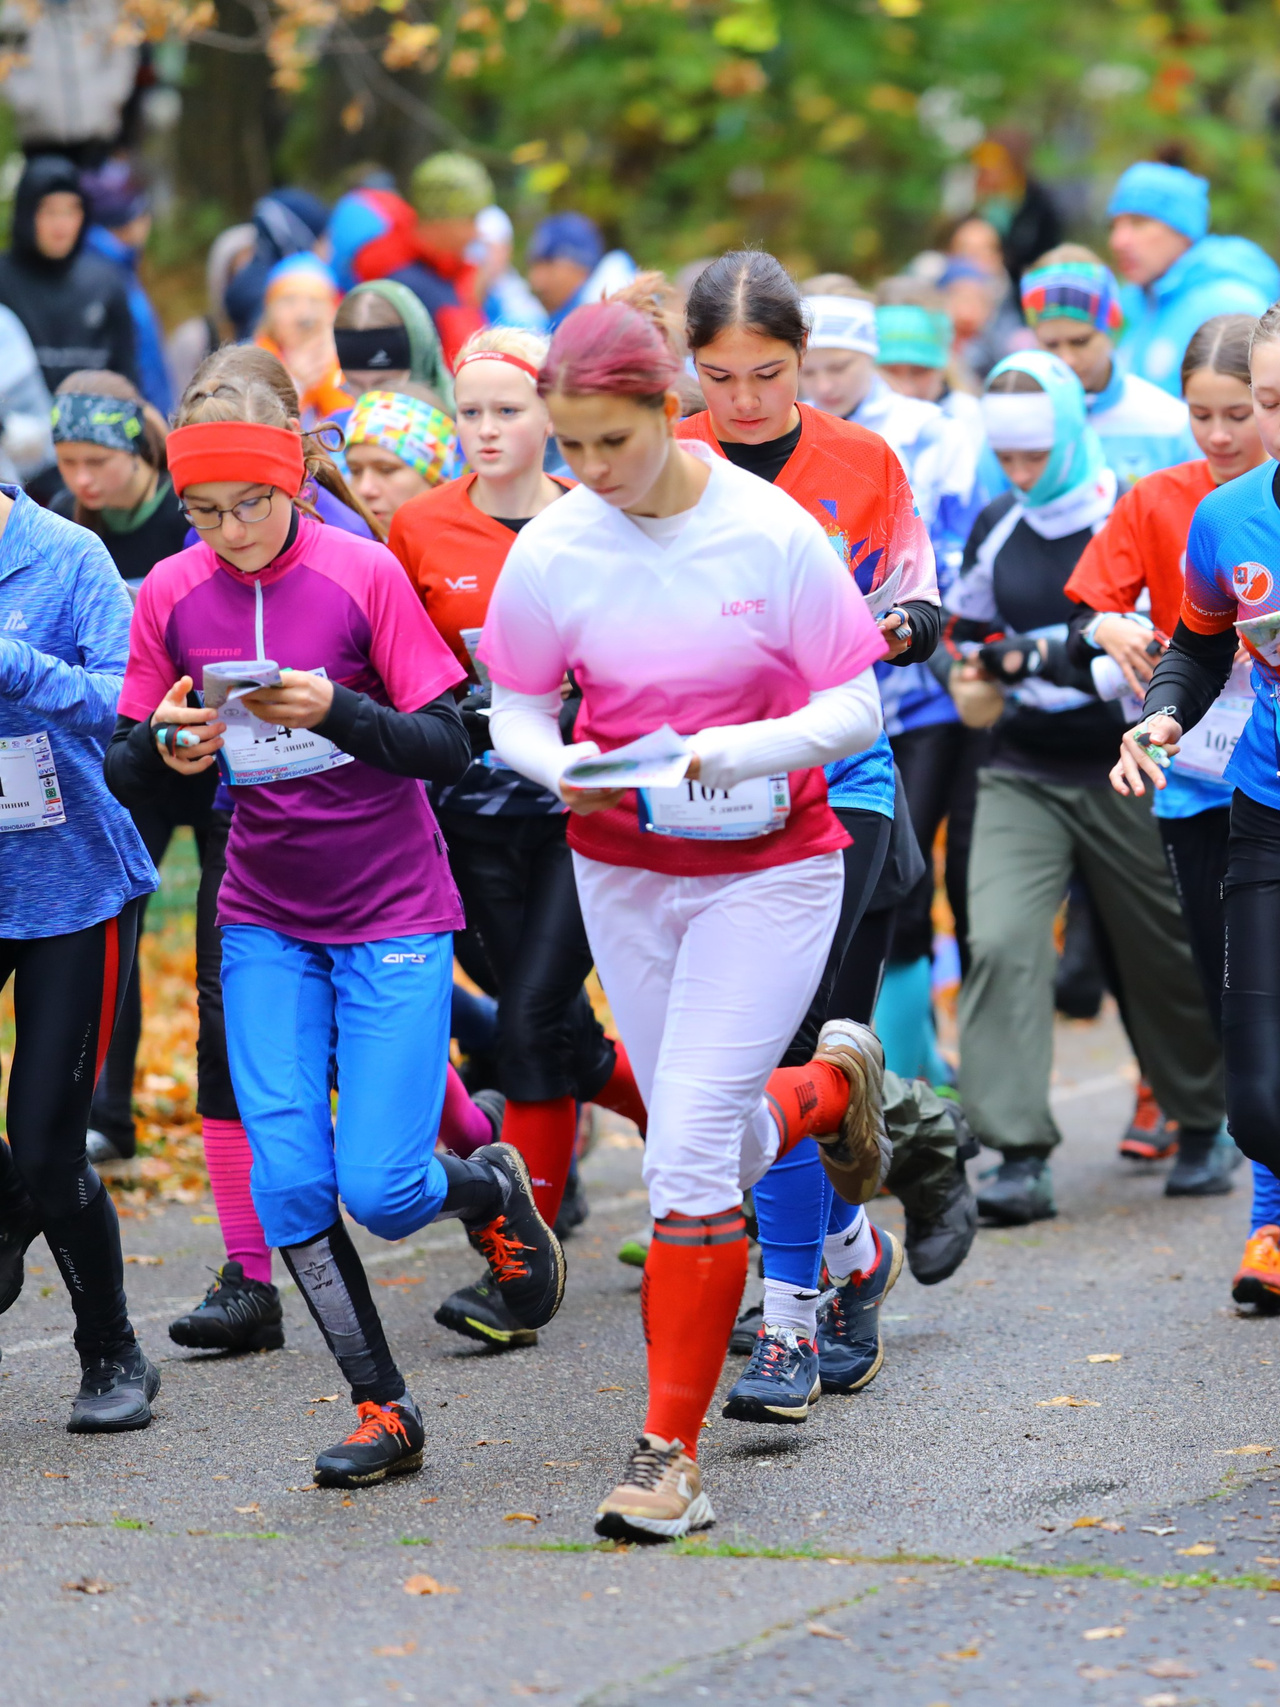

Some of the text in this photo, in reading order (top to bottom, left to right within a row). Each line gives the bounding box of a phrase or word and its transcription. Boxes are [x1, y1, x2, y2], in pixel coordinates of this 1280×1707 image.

[188, 648, 242, 657] noname
[274, 746, 281, 755] 5
[283, 741, 315, 753] линия
